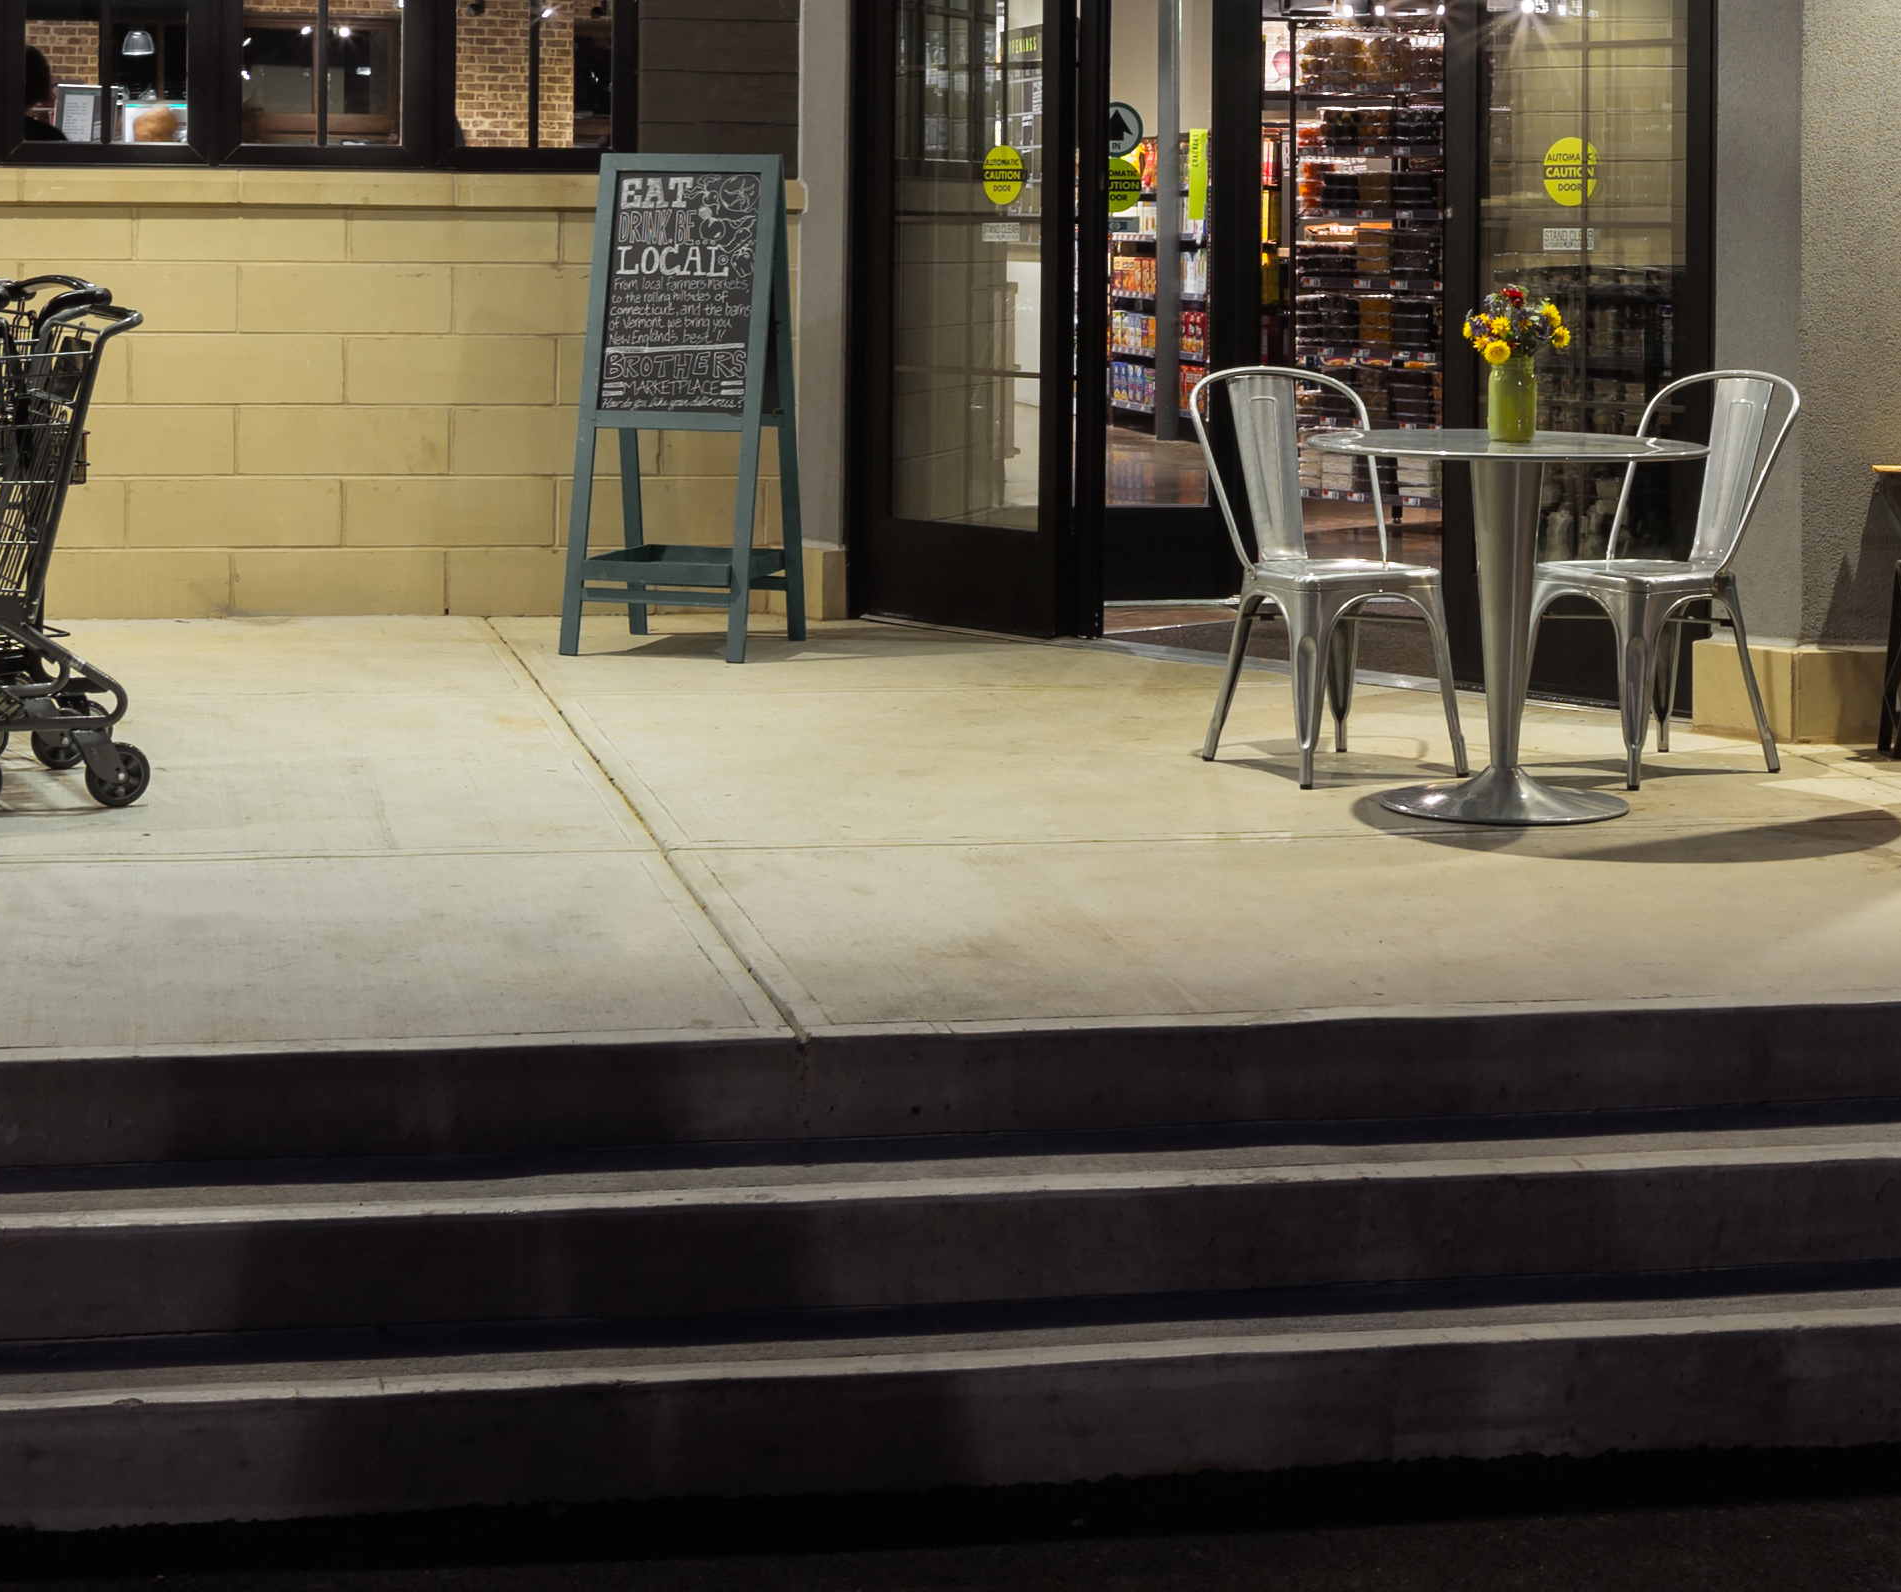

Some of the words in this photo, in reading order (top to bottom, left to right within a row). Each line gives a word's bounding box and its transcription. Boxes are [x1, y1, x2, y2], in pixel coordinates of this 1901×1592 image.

[1112, 142, 1121, 150] IN
[984, 158, 1020, 166] AUTOMATIC
[1546, 152, 1593, 162] AUTOMAC
[983, 171, 1021, 180] CAUTION
[1109, 169, 1138, 177] OMATIC
[1545, 167, 1595, 178] CAUTION
[1109, 181, 1139, 190] UTION
[1557, 183, 1583, 192] DOOR
[620, 176, 694, 209] EAT
[1109, 193, 1128, 202] OOR
[618, 209, 673, 246] DRINK.
[1544, 229, 1568, 242] STAND
[1569, 229, 1594, 242] CLER
[616, 243, 730, 278] LOCAL
[614, 277, 639, 291] From
[642, 276, 664, 290] local
[666, 275, 707, 291] farmers
[611, 293, 623, 303] to
[624, 291, 642, 303] the
[643, 291, 672, 306] rolling
[672, 289, 711, 302] hillsides
[714, 289, 729, 304] of
[679, 302, 701, 316] and
[702, 302, 723, 316] the
[725, 301, 752, 317] barns
[608, 316, 621, 331] of
[622, 315, 665, 329] Vermont
[667, 317, 683, 328] we
[684, 315, 711, 333] bring
[712, 318, 733, 333] you
[602, 350, 748, 380] BROTHERS
[623, 379, 721, 396] MARKETPLACE
